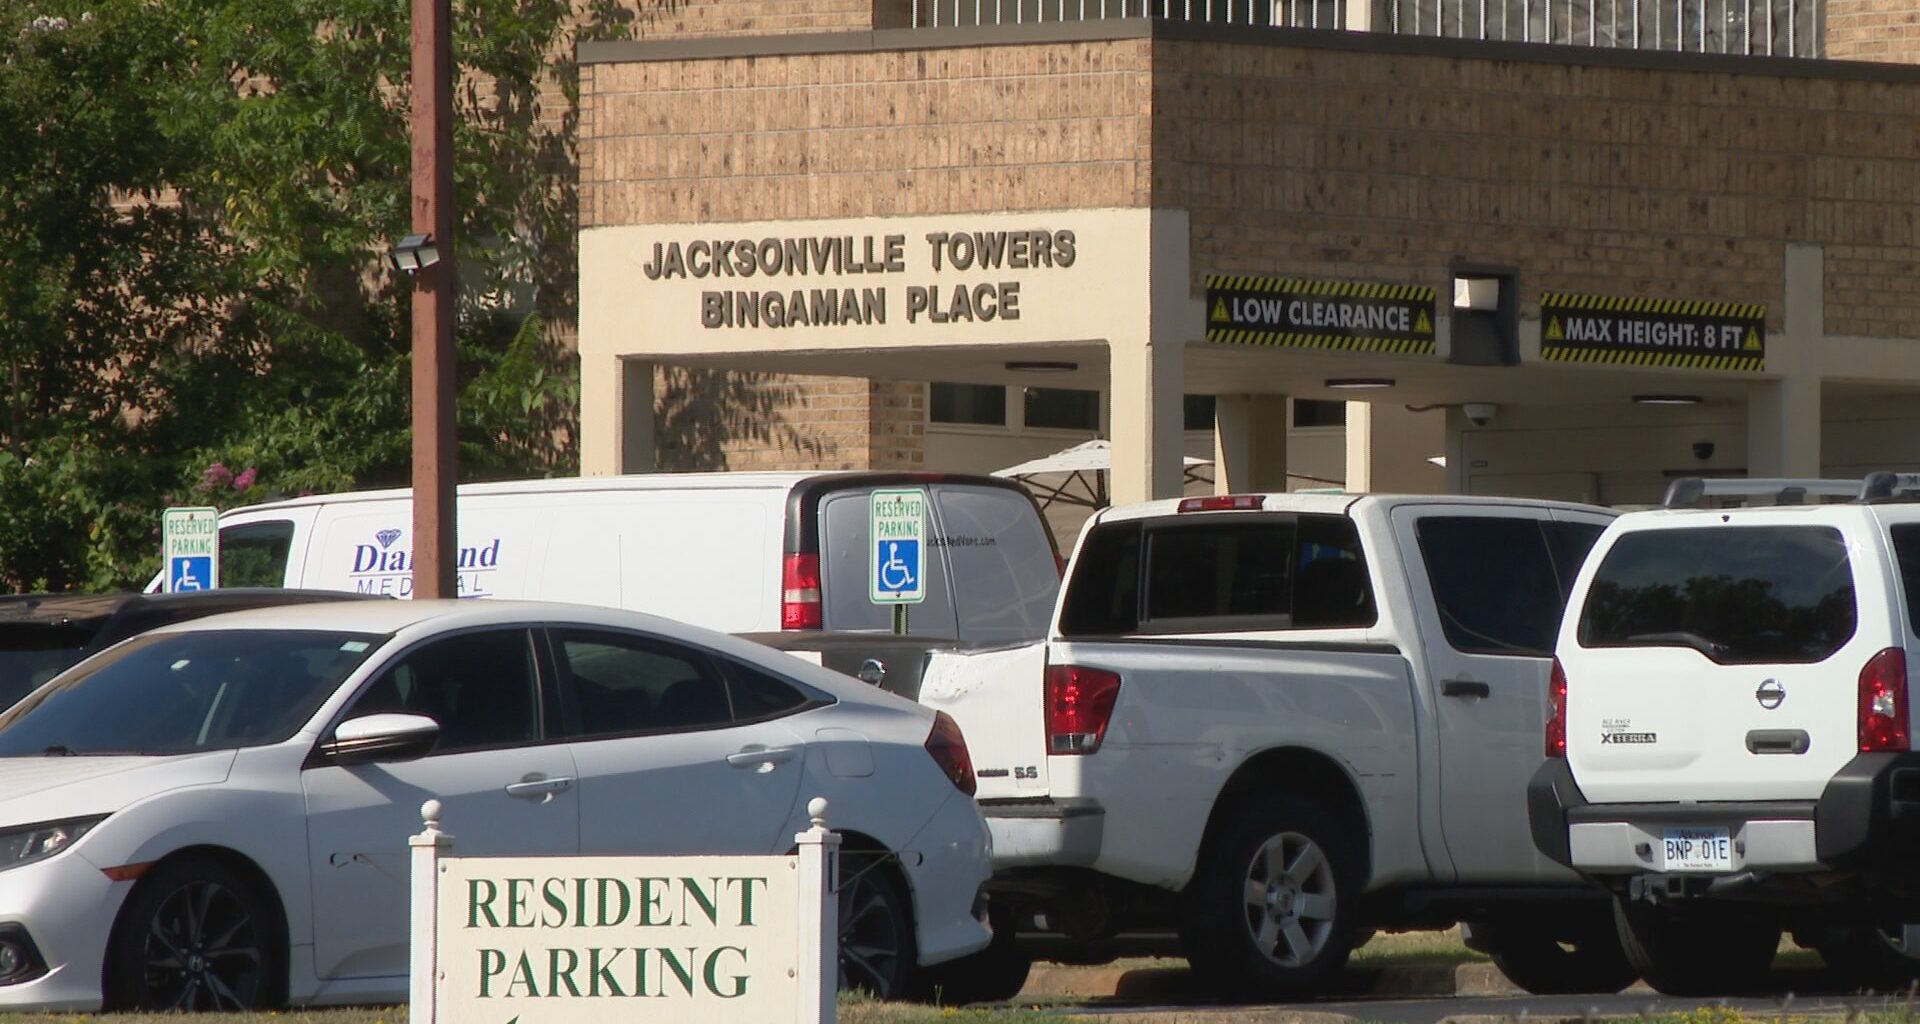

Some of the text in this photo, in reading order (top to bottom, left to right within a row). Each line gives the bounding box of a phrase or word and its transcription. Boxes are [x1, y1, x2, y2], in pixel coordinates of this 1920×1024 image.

[643, 229, 1076, 280] JACKSONVILLE TOWERS
[700, 281, 1020, 328] BINGAMAN PLACE
[1232, 297, 1410, 332] LOW CLEARANCE
[1565, 316, 1743, 350] MAX HEIGHT: 8 FT
[875, 500, 921, 518] RESERVED
[168, 518, 214, 535] RESERVED
[878, 520, 919, 537] PARKING
[172, 538, 211, 554] PARKING
[352, 538, 500, 573] Diand
[357, 574, 483, 596] MEDAL
[1666, 840, 1692, 860] BNP
[463, 876, 768, 928] RESIDENT
[475, 945, 751, 999] PARKING
